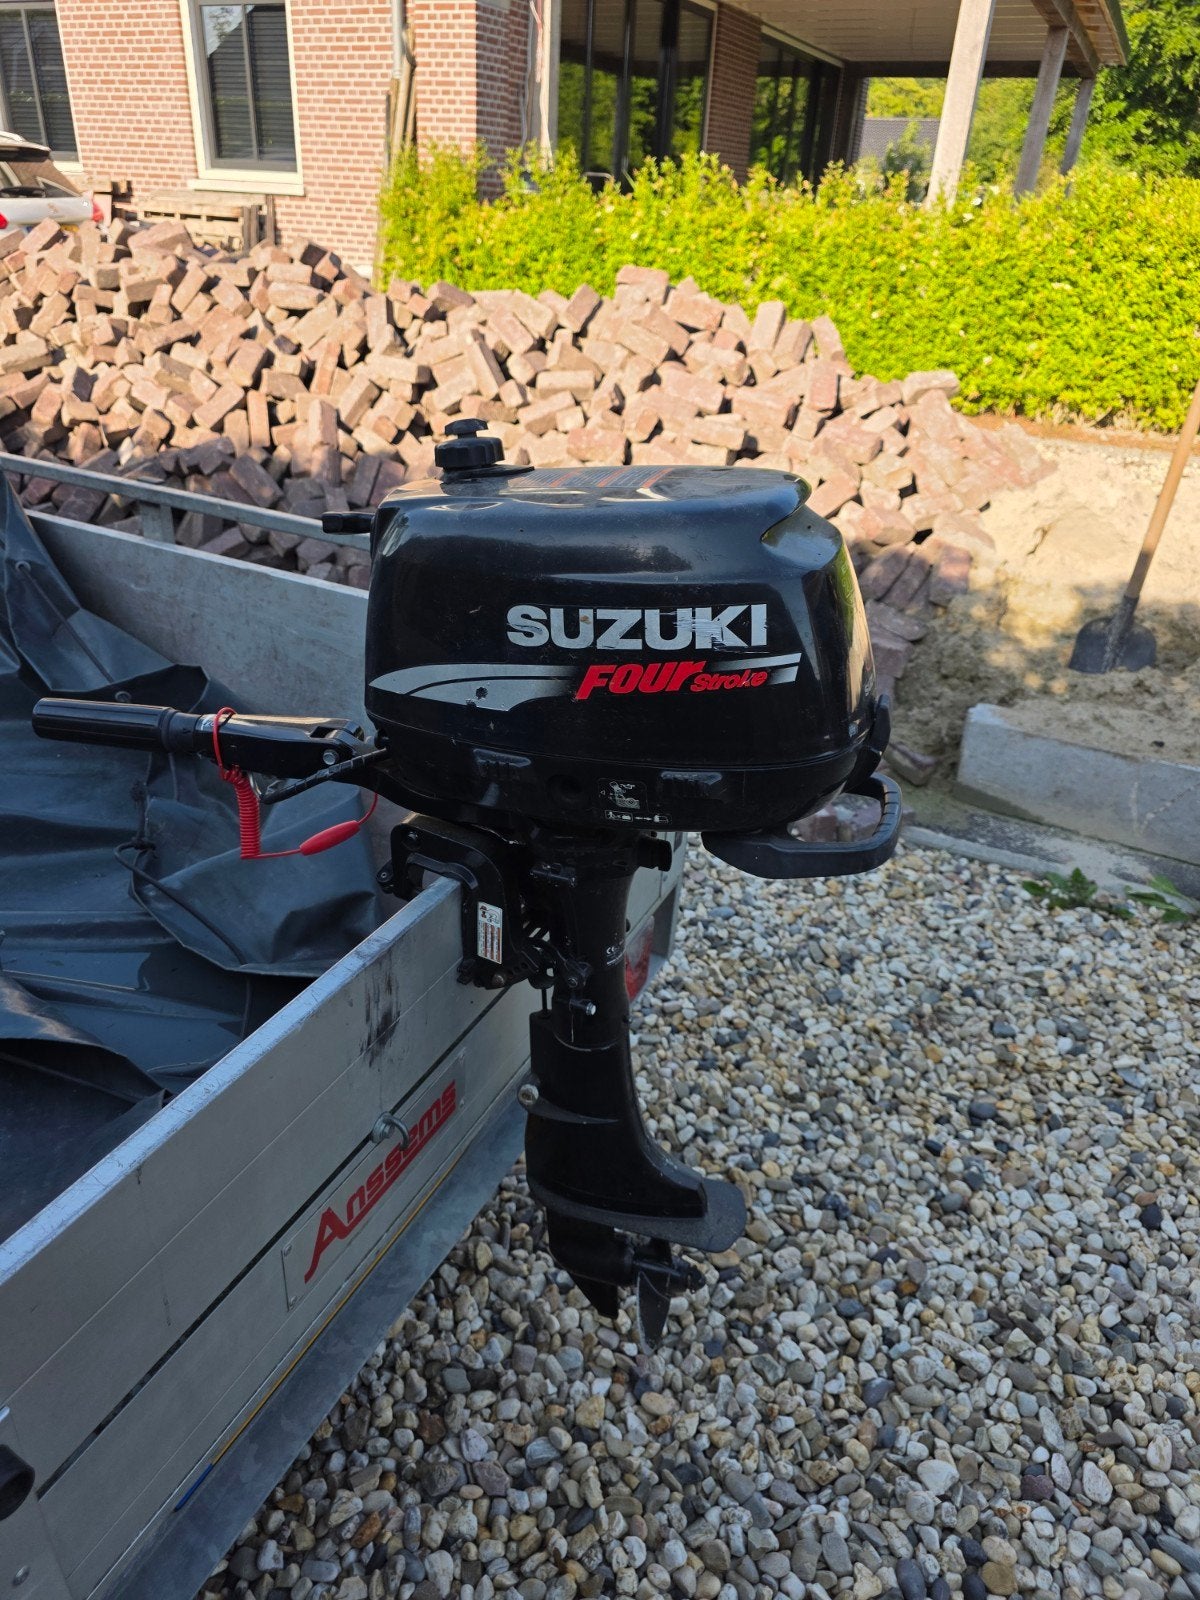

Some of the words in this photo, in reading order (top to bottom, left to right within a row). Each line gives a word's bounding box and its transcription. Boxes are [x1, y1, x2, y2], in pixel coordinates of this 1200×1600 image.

[506, 603, 768, 650] SUZUKI
[690, 669, 768, 692] Stroke
[304, 1079, 456, 1284] Anssems
